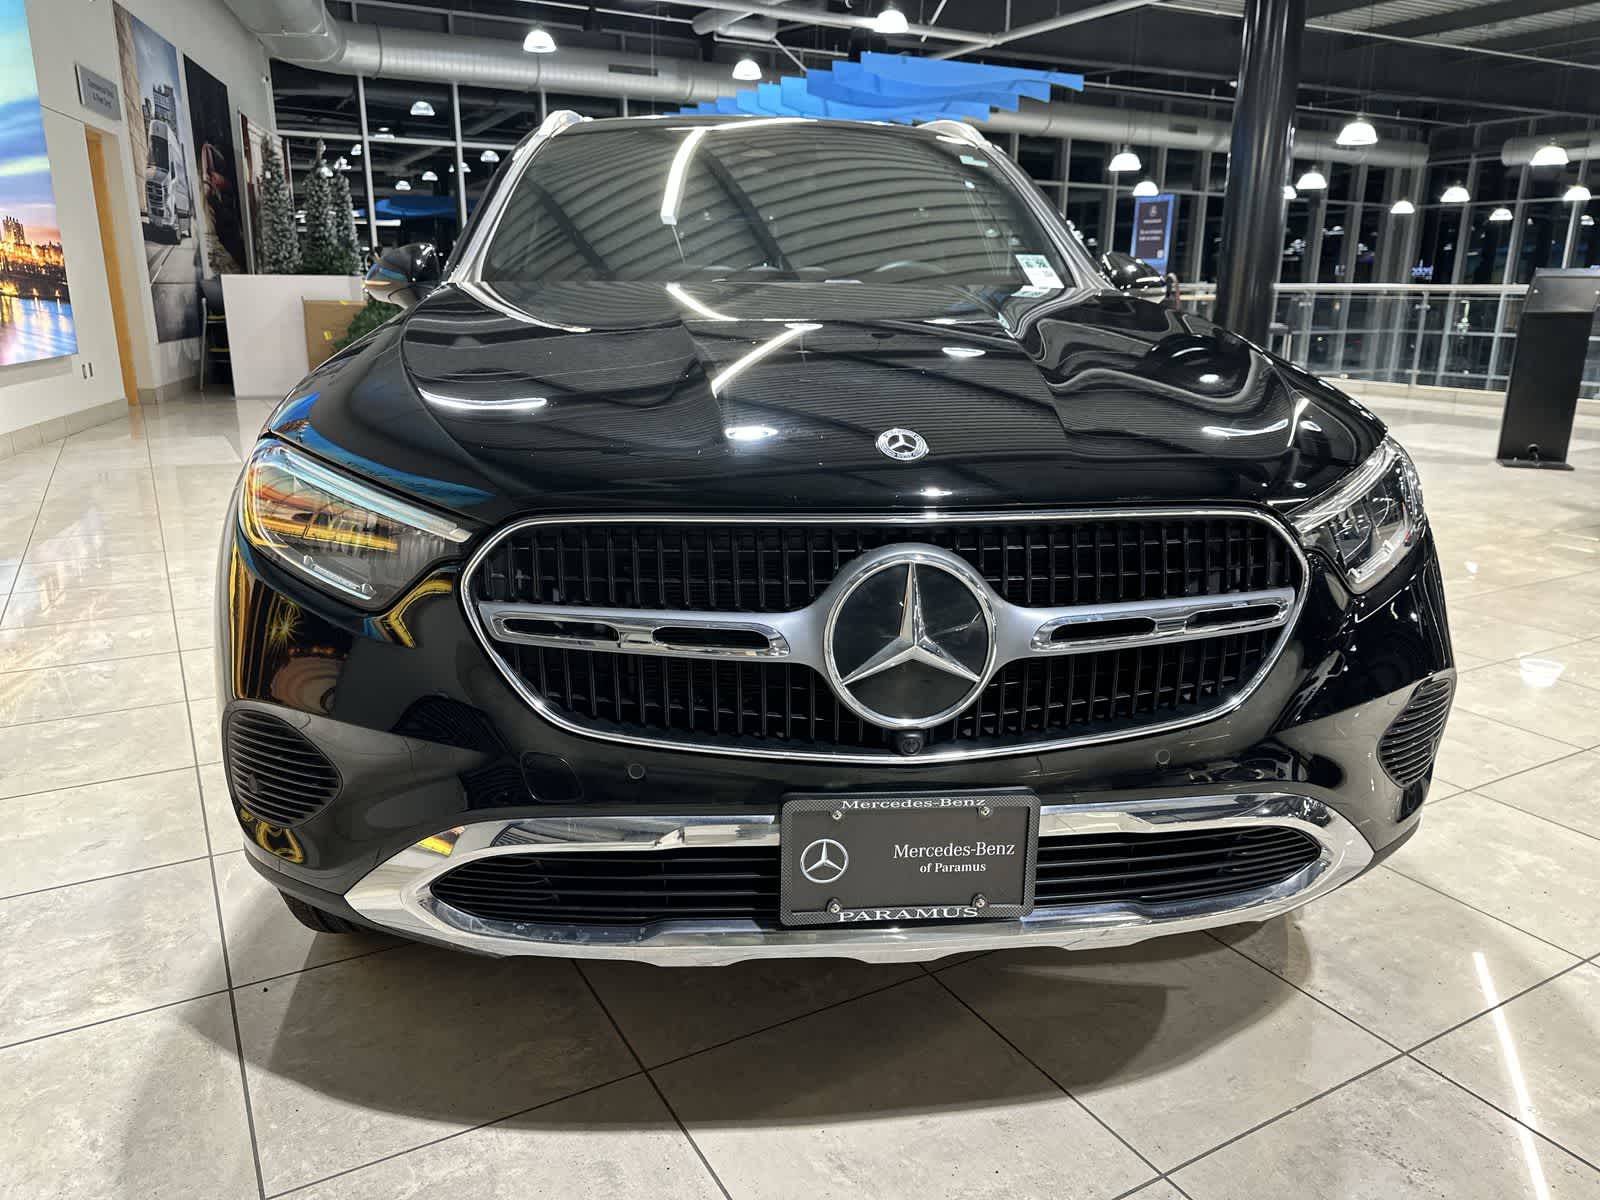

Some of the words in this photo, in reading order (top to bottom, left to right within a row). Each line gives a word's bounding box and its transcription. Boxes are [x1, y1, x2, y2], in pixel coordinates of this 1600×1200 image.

[841, 798, 986, 809] Mercedes-Benz
[893, 841, 1015, 859] Mercedes-Benz
[919, 862, 932, 873] of
[934, 862, 986, 873] Paramus
[839, 907, 978, 922] PARAMUS
